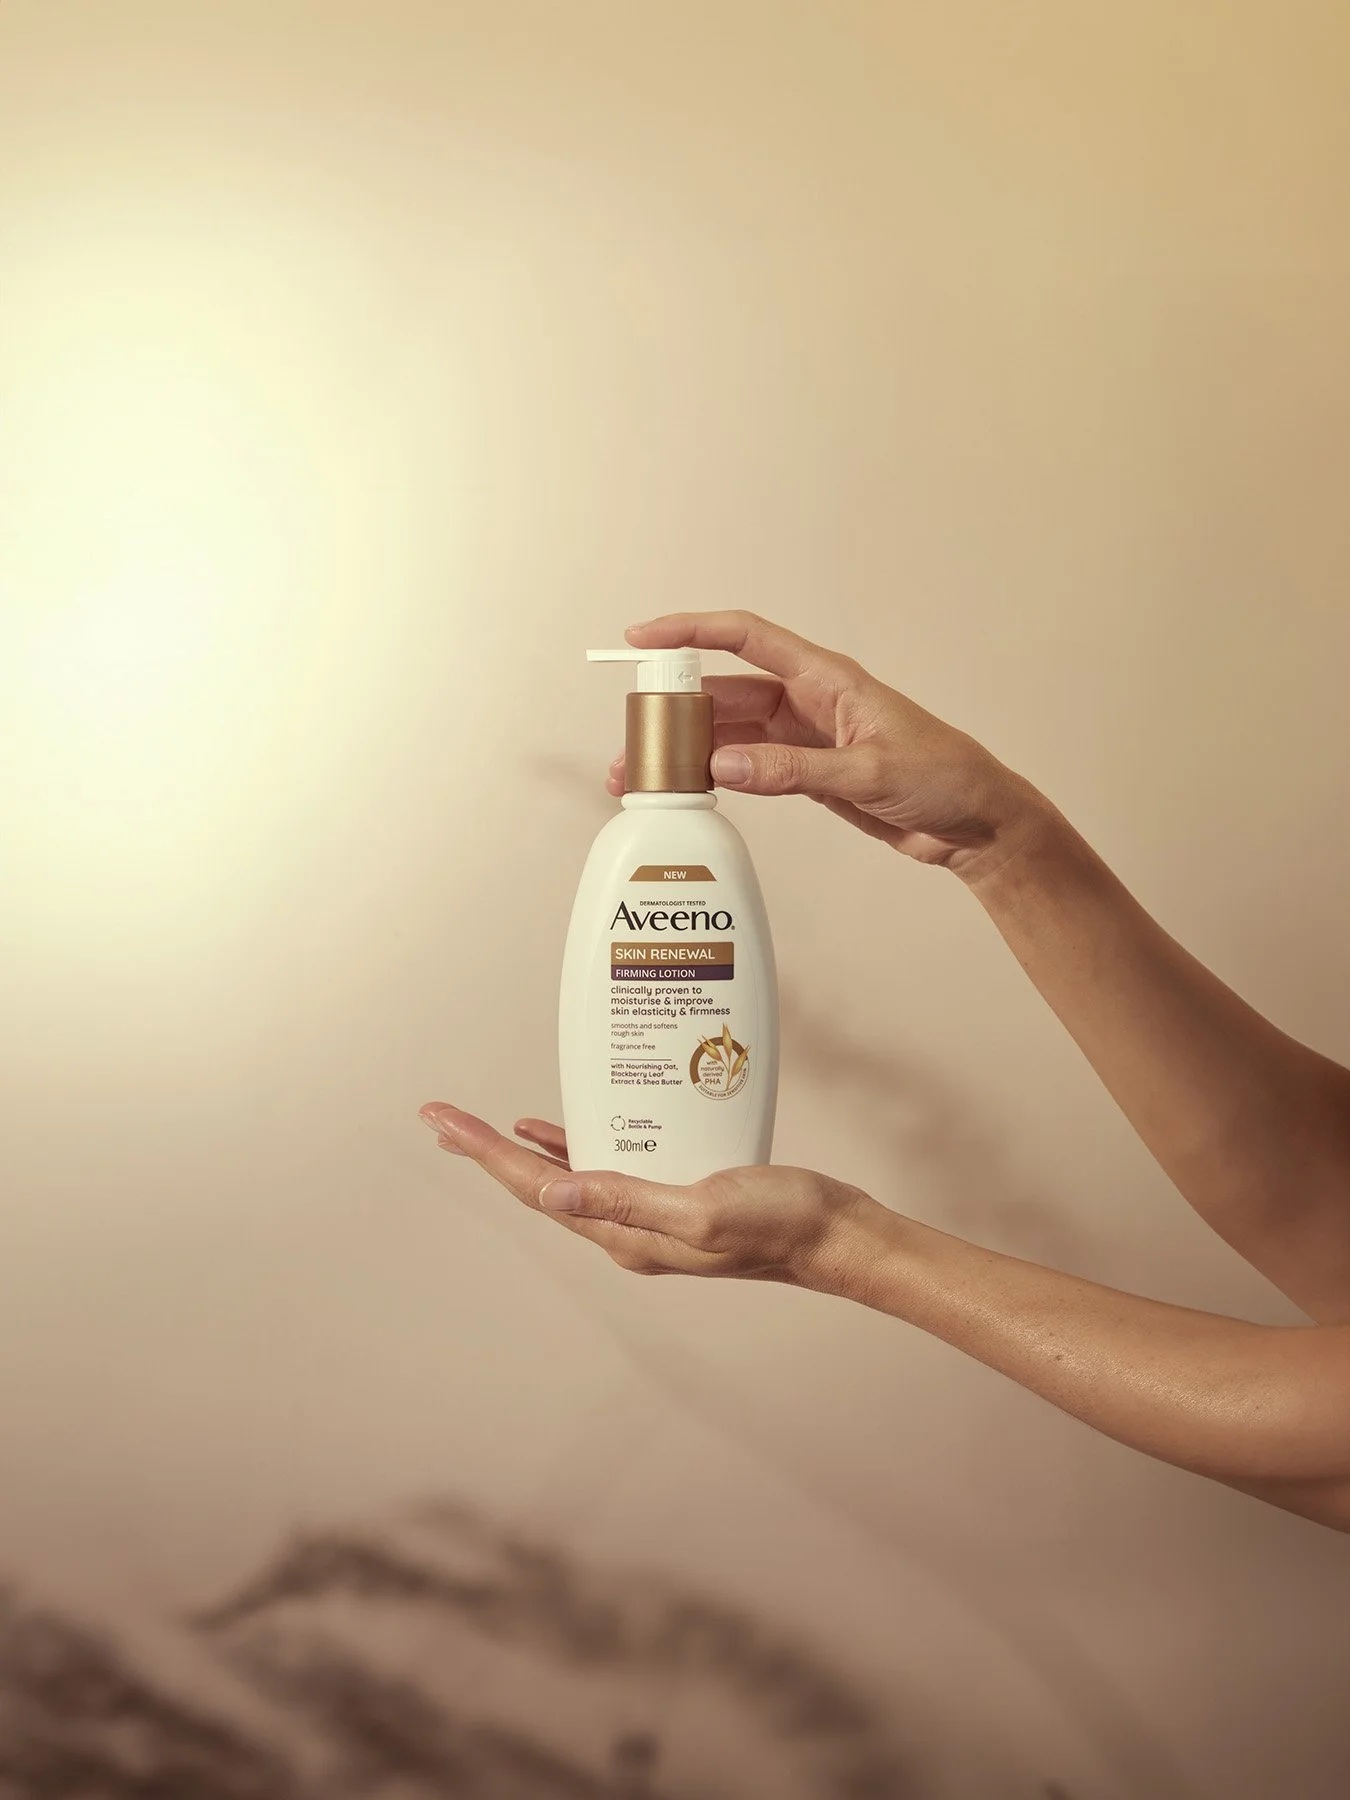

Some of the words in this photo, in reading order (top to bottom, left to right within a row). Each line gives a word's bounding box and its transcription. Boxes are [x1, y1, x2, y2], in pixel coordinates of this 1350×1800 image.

[664, 871, 686, 880] NEW
[615, 948, 646, 960] SKIN
[650, 948, 715, 960] RENEWAL
[616, 969, 656, 978] FIRMING
[659, 969, 696, 978] LOTION
[610, 986, 652, 996] clinically
[655, 987, 689, 996] proven
[610, 997, 661, 1005] moisturise
[664, 997, 672, 1005] &
[674, 997, 714, 1007] improve
[610, 1007, 630, 1015] skin
[632, 1007, 676, 1017] elasticity
[679, 1007, 686, 1015] &
[690, 1007, 730, 1015] firmness
